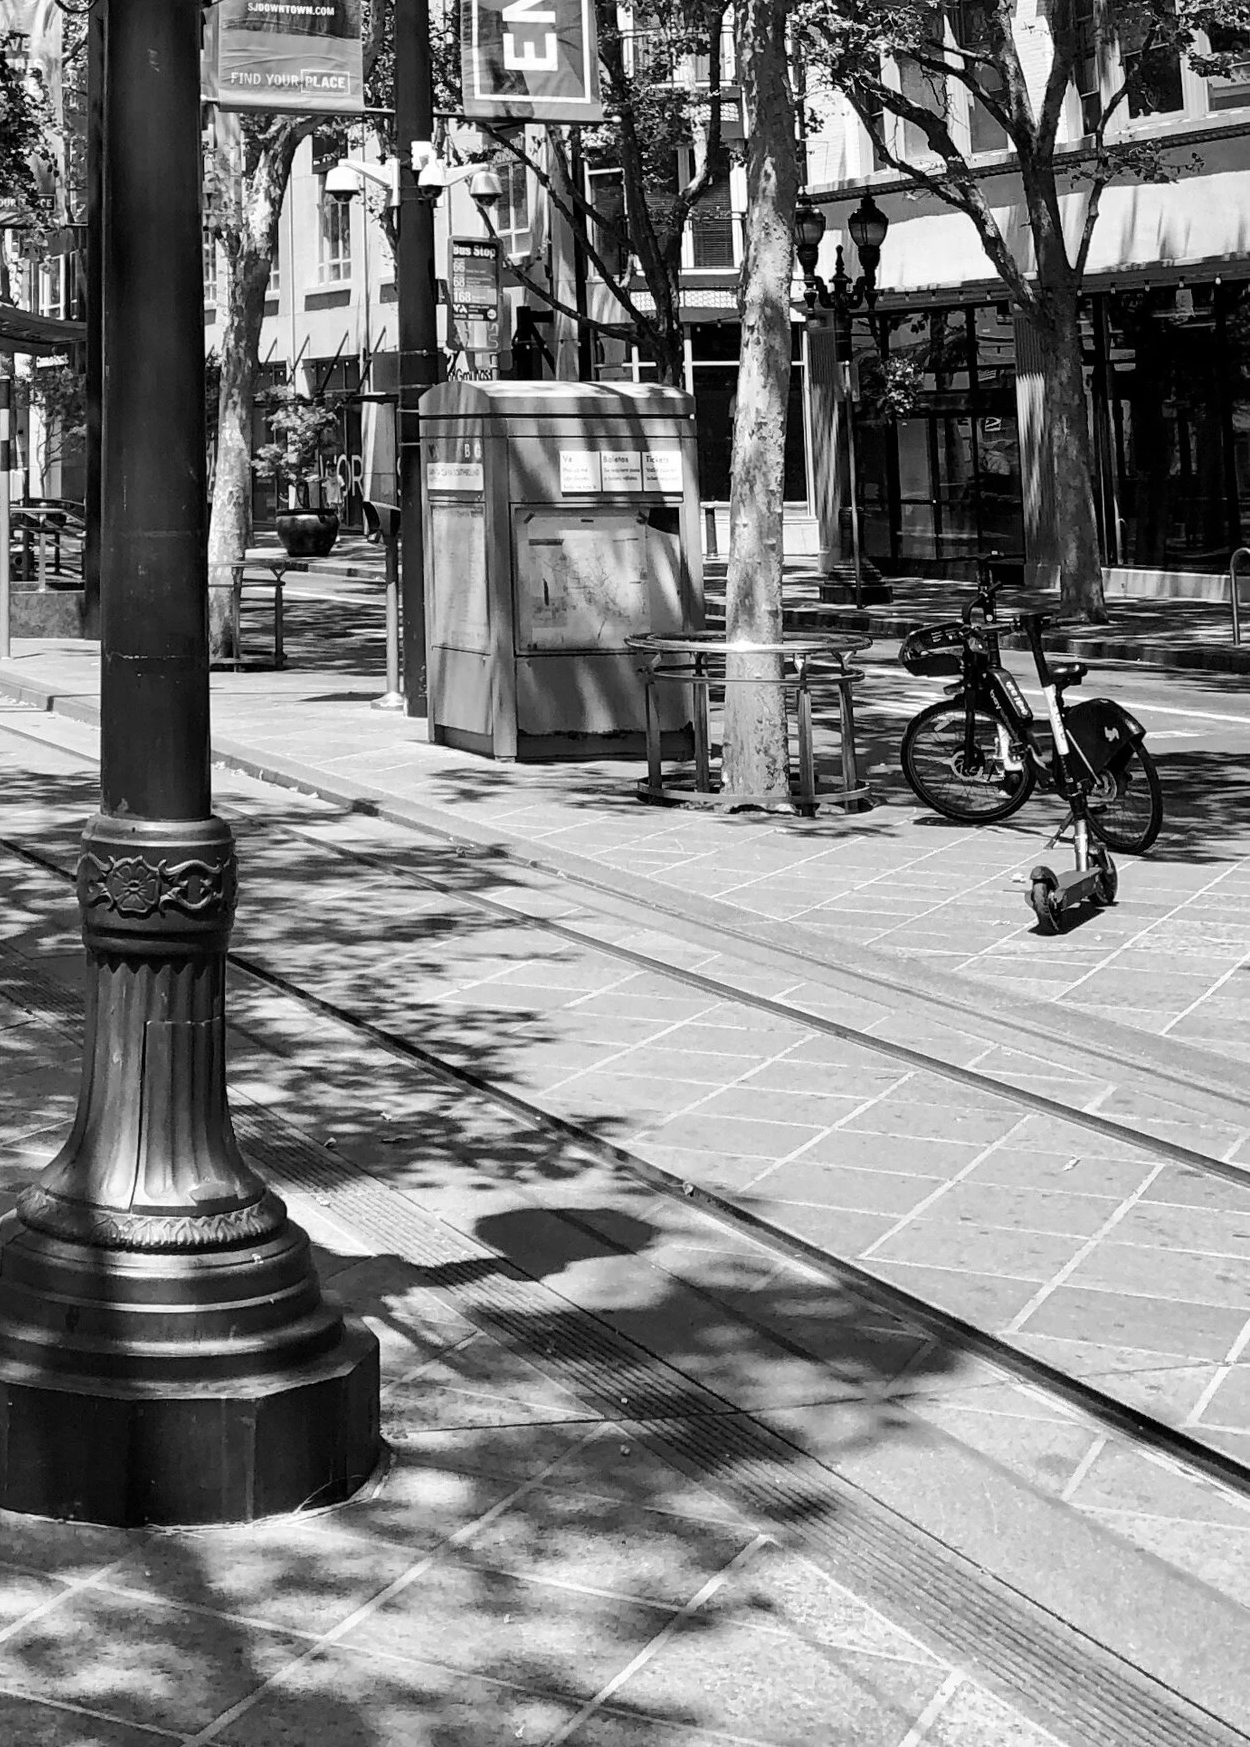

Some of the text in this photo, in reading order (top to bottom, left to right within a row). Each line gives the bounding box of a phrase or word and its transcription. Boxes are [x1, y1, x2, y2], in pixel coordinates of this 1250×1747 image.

[247, 2, 334, 16] SJDOWNTOWN.COM
[230, 71, 346, 89] FIND YOUR PLACE
[453, 243, 496, 260] Bus Stop
[453, 291, 472, 304] 168
